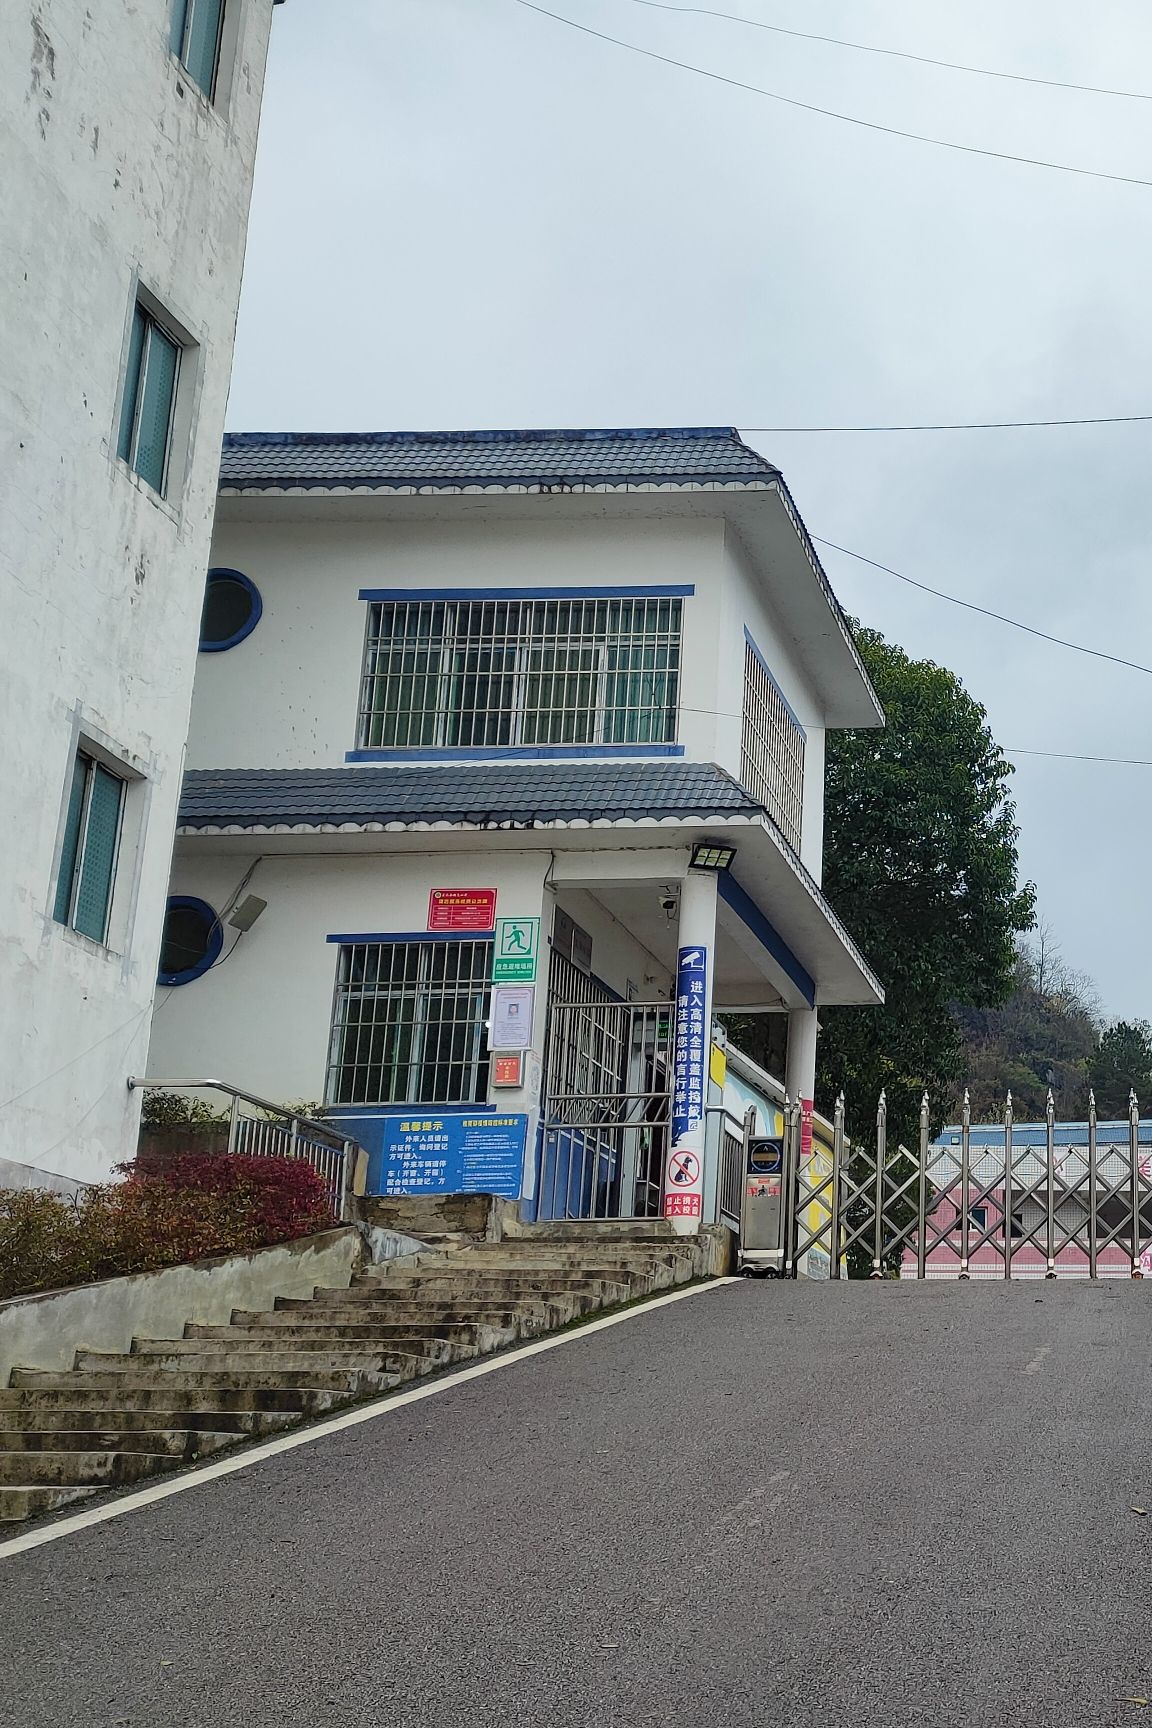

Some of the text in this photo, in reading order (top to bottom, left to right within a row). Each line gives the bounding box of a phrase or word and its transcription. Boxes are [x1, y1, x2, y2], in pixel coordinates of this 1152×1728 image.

[673, 994, 689, 1118] 请注意您的言行举止
[399, 1121, 444, 1132] 温馨提示
